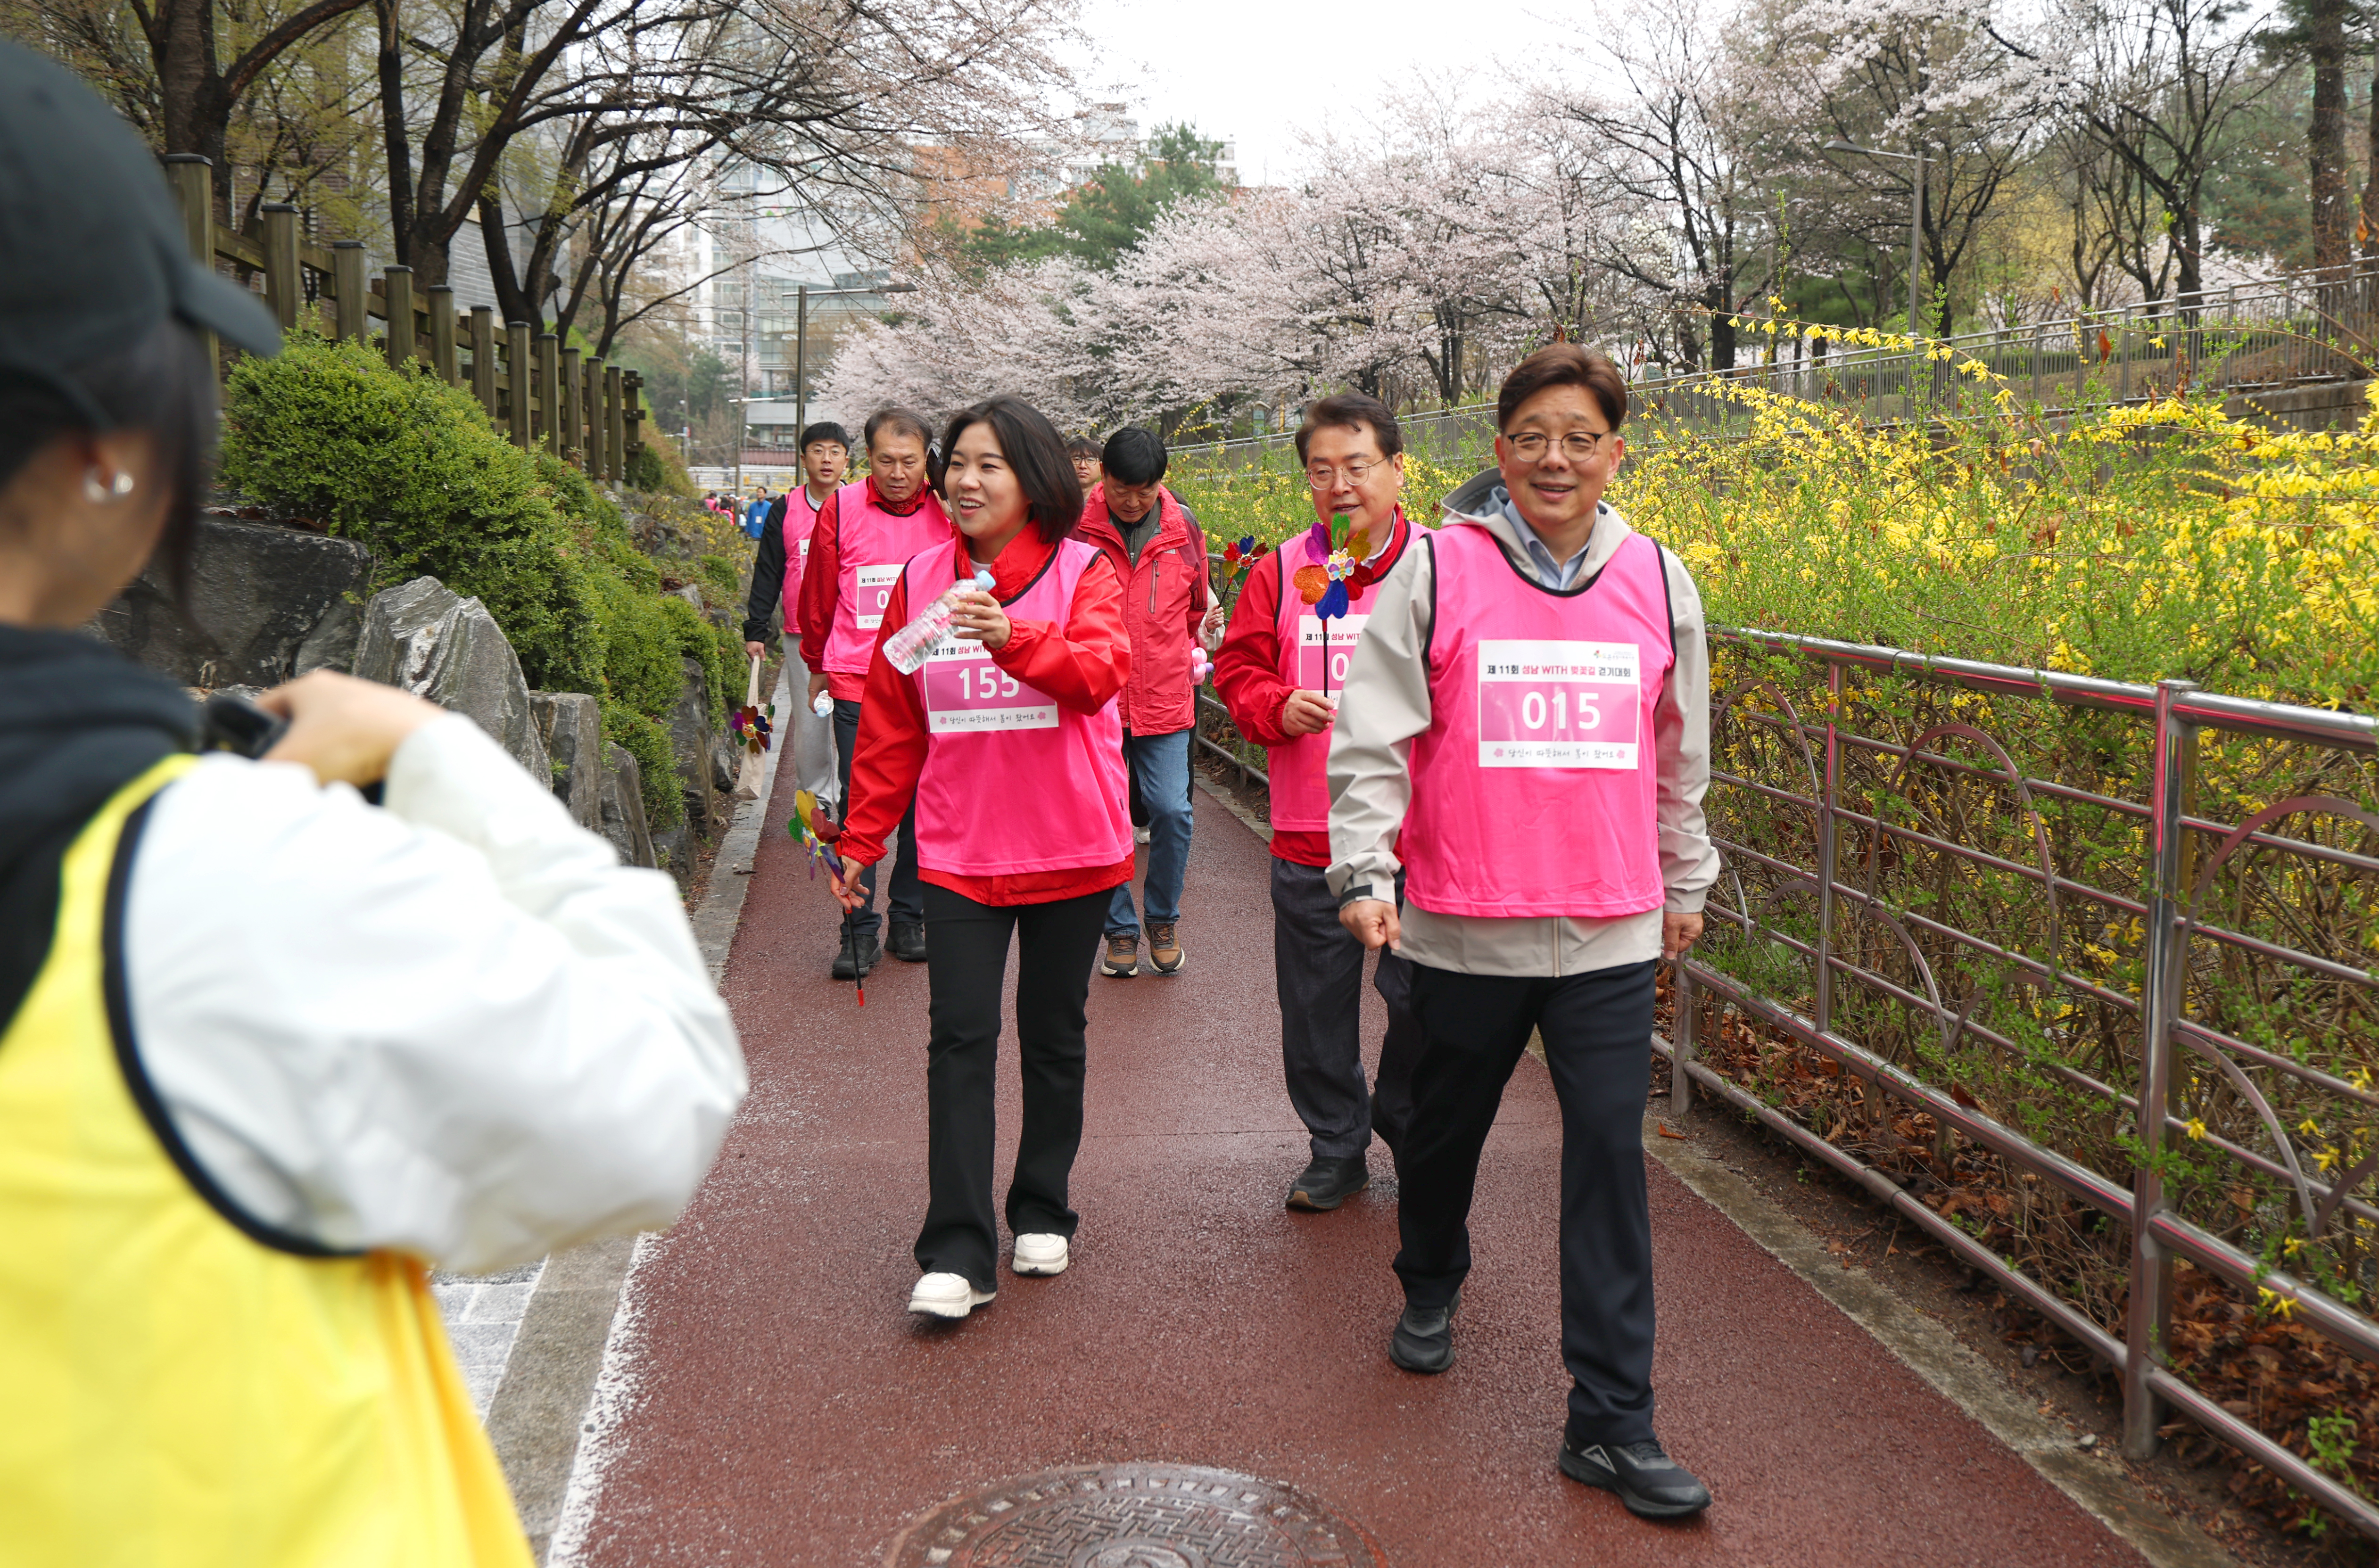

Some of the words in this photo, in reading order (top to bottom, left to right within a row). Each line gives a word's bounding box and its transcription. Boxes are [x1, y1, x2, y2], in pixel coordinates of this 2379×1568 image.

[877, 590, 889, 609] 0
[942, 646, 956, 655] 11회
[958, 646, 971, 654] 성남
[1331, 652, 1350, 681] 0
[1487, 665, 1496, 675] 제
[1499, 665, 1519, 675] 11회
[1522, 665, 1540, 675] 성남
[1542, 665, 1568, 675] WITH
[1571, 666, 1596, 676] 벚꽃길
[1599, 666, 1631, 677] 걷기대회
[958, 666, 1019, 700] 155
[1522, 691, 1601, 730] 015
[950, 716, 966, 725] 당신이
[969, 714, 996, 724] 따뜻해서
[1000, 713, 1012, 723] 봄이
[1016, 713, 1035, 722] 왔어요
[1508, 748, 1532, 758] 당신이
[1536, 748, 1570, 759] 따뜻해서
[1576, 748, 1589, 759] 봄이
[1594, 749, 1614, 759] 왔어요
